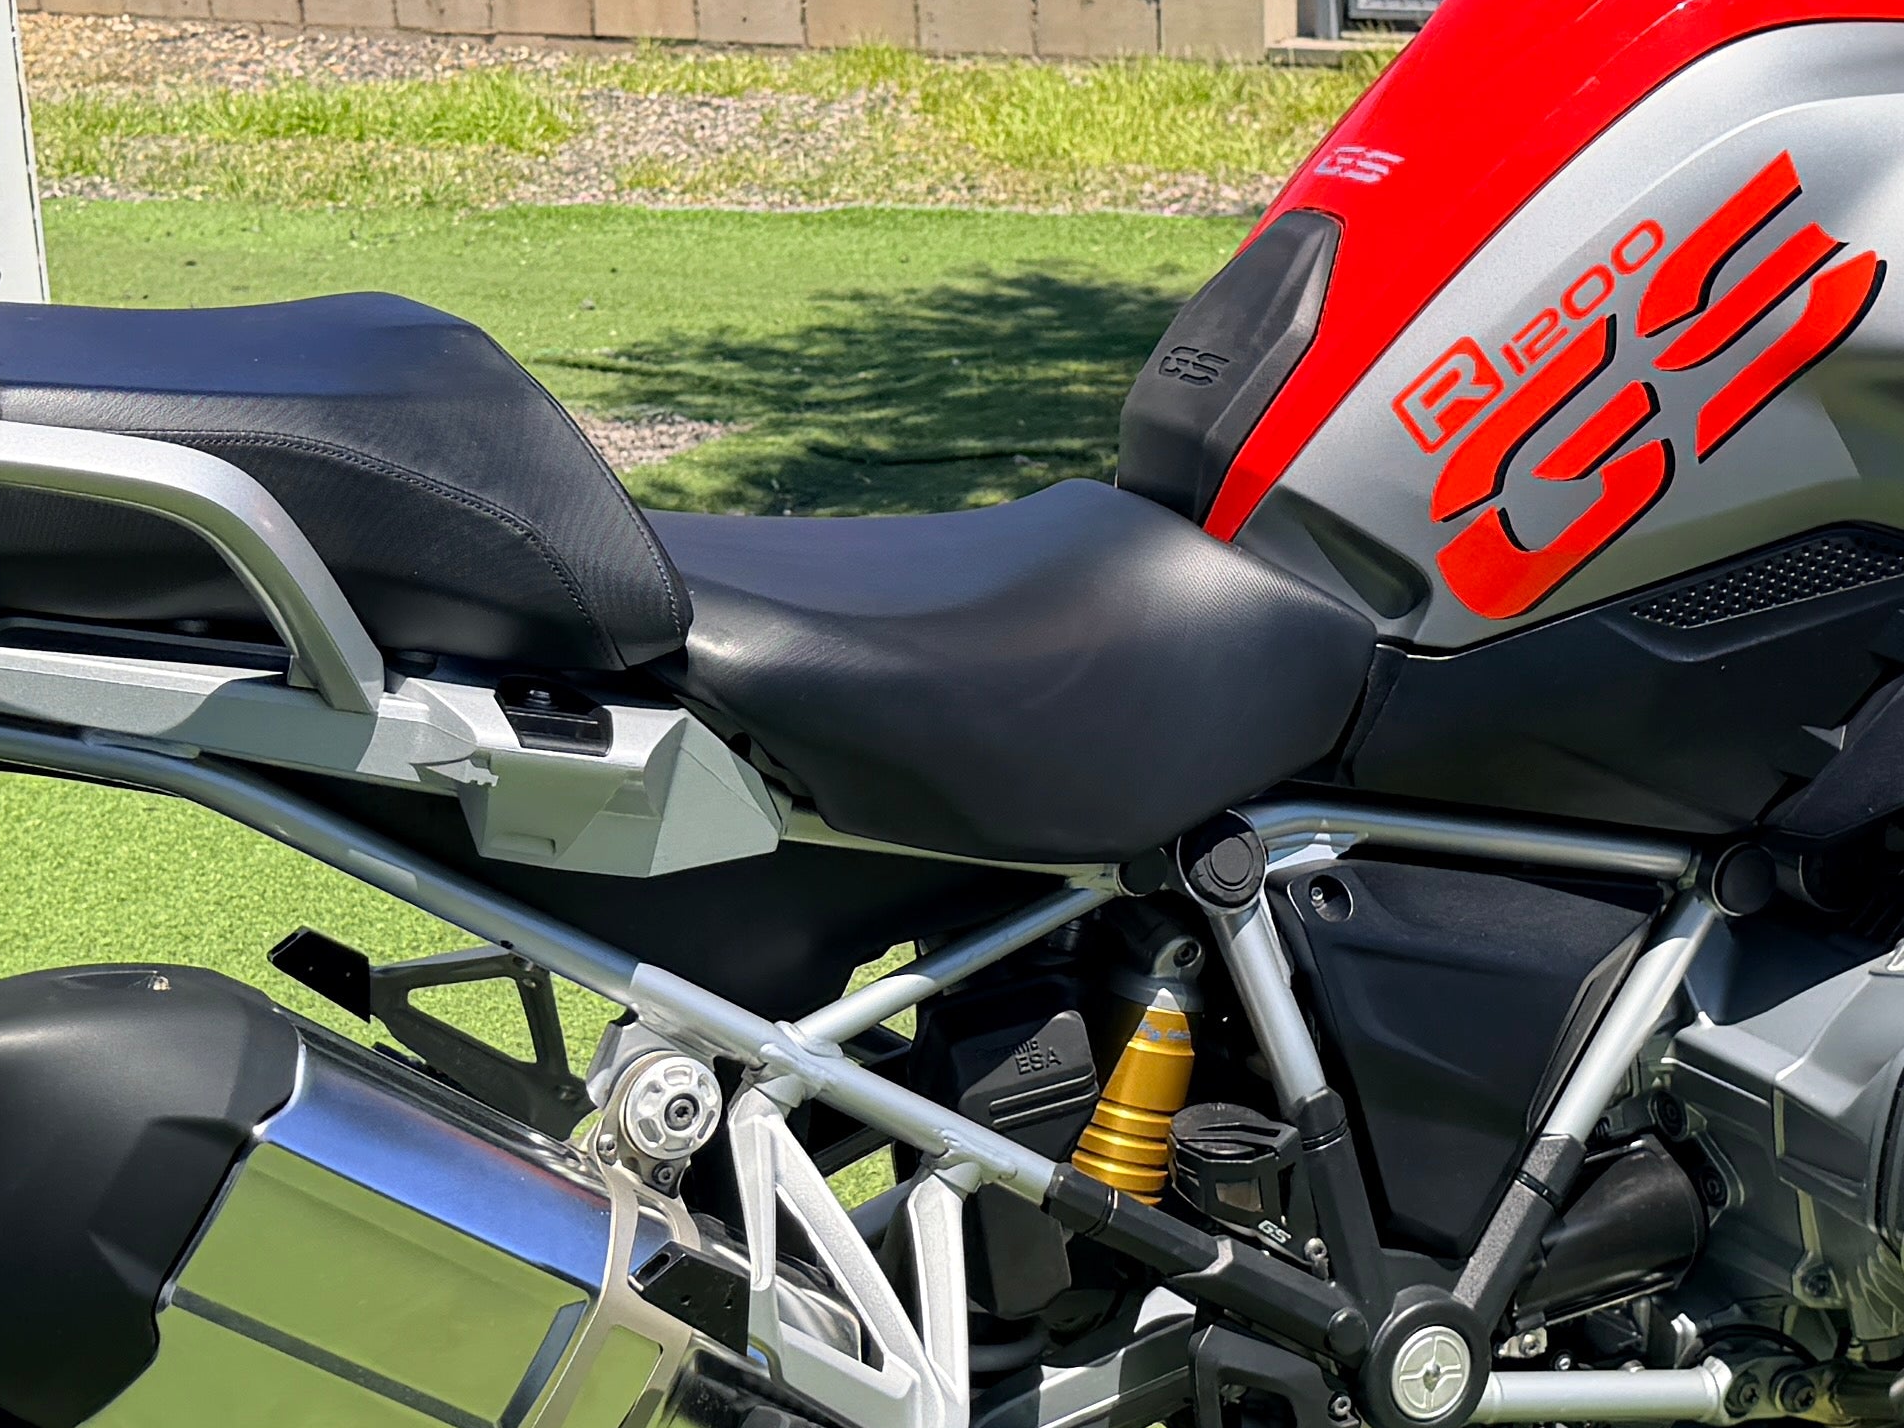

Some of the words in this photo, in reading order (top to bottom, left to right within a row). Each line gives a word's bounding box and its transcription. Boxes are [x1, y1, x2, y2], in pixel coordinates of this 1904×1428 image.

[1395, 341, 1501, 452] R
[1499, 219, 1666, 377] 1200
[1431, 149, 1886, 620] GS
[1016, 1046, 1062, 1075] ESA
[1257, 1219, 1292, 1245] GS
